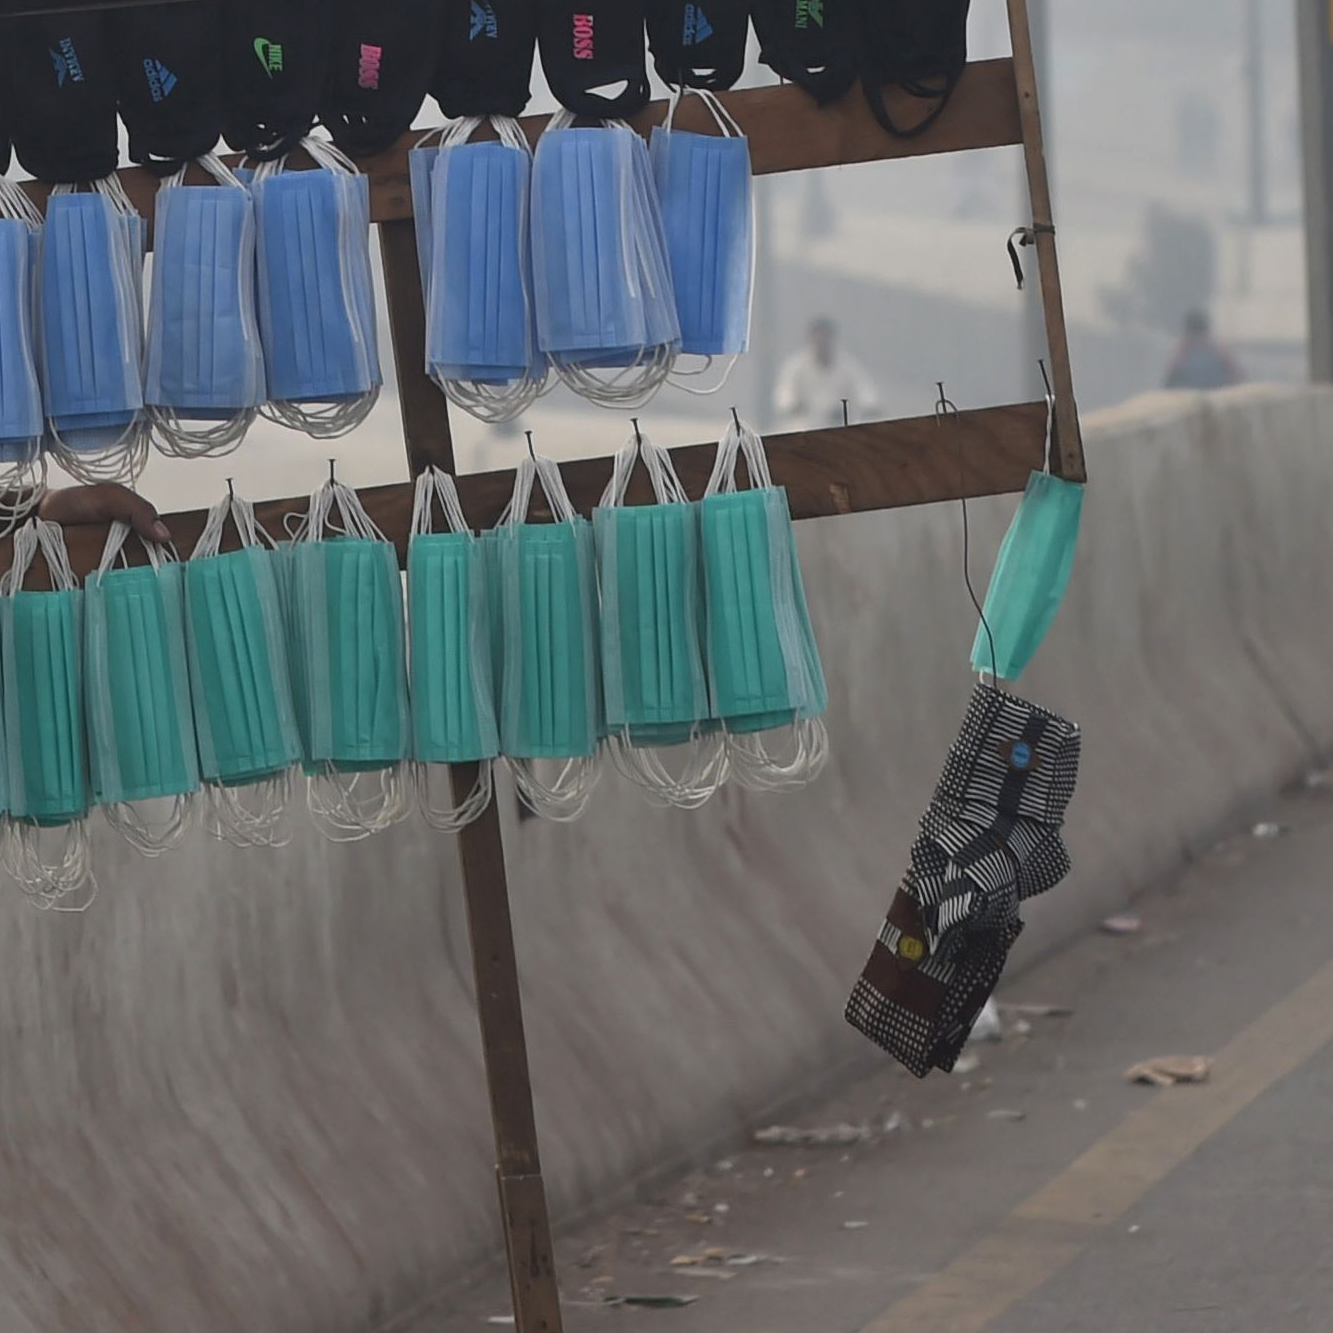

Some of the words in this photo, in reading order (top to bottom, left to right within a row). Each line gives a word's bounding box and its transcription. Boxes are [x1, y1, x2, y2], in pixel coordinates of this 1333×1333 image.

[268, 44, 283, 71] NIKE
[572, 13, 594, 59] BOSS
[59, 37, 85, 83] ARMANI
[143, 58, 163, 103] adidas
[358, 43, 382, 90] BOSS
